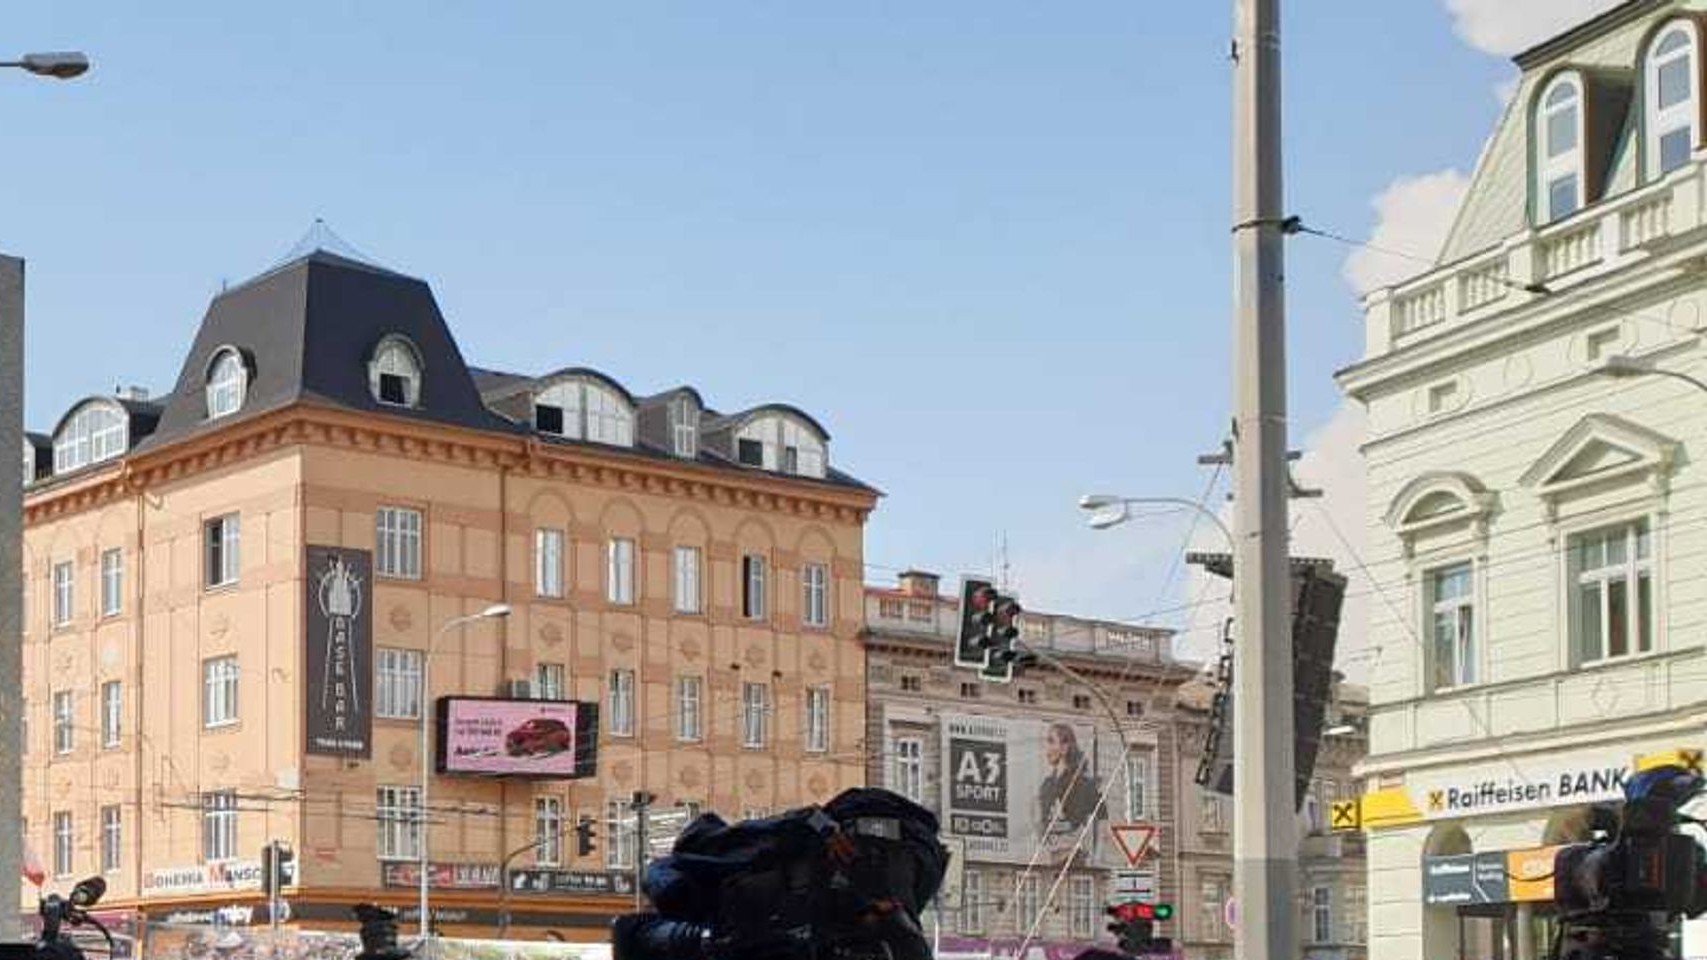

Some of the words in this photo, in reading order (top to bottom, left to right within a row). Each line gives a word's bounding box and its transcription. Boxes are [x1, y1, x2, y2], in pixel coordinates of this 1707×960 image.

[957, 751, 1001, 783] A3
[955, 784, 1000, 801] SPORT
[1448, 779, 1551, 809] Raiffeisen
[1559, 767, 1627, 797] BANK
